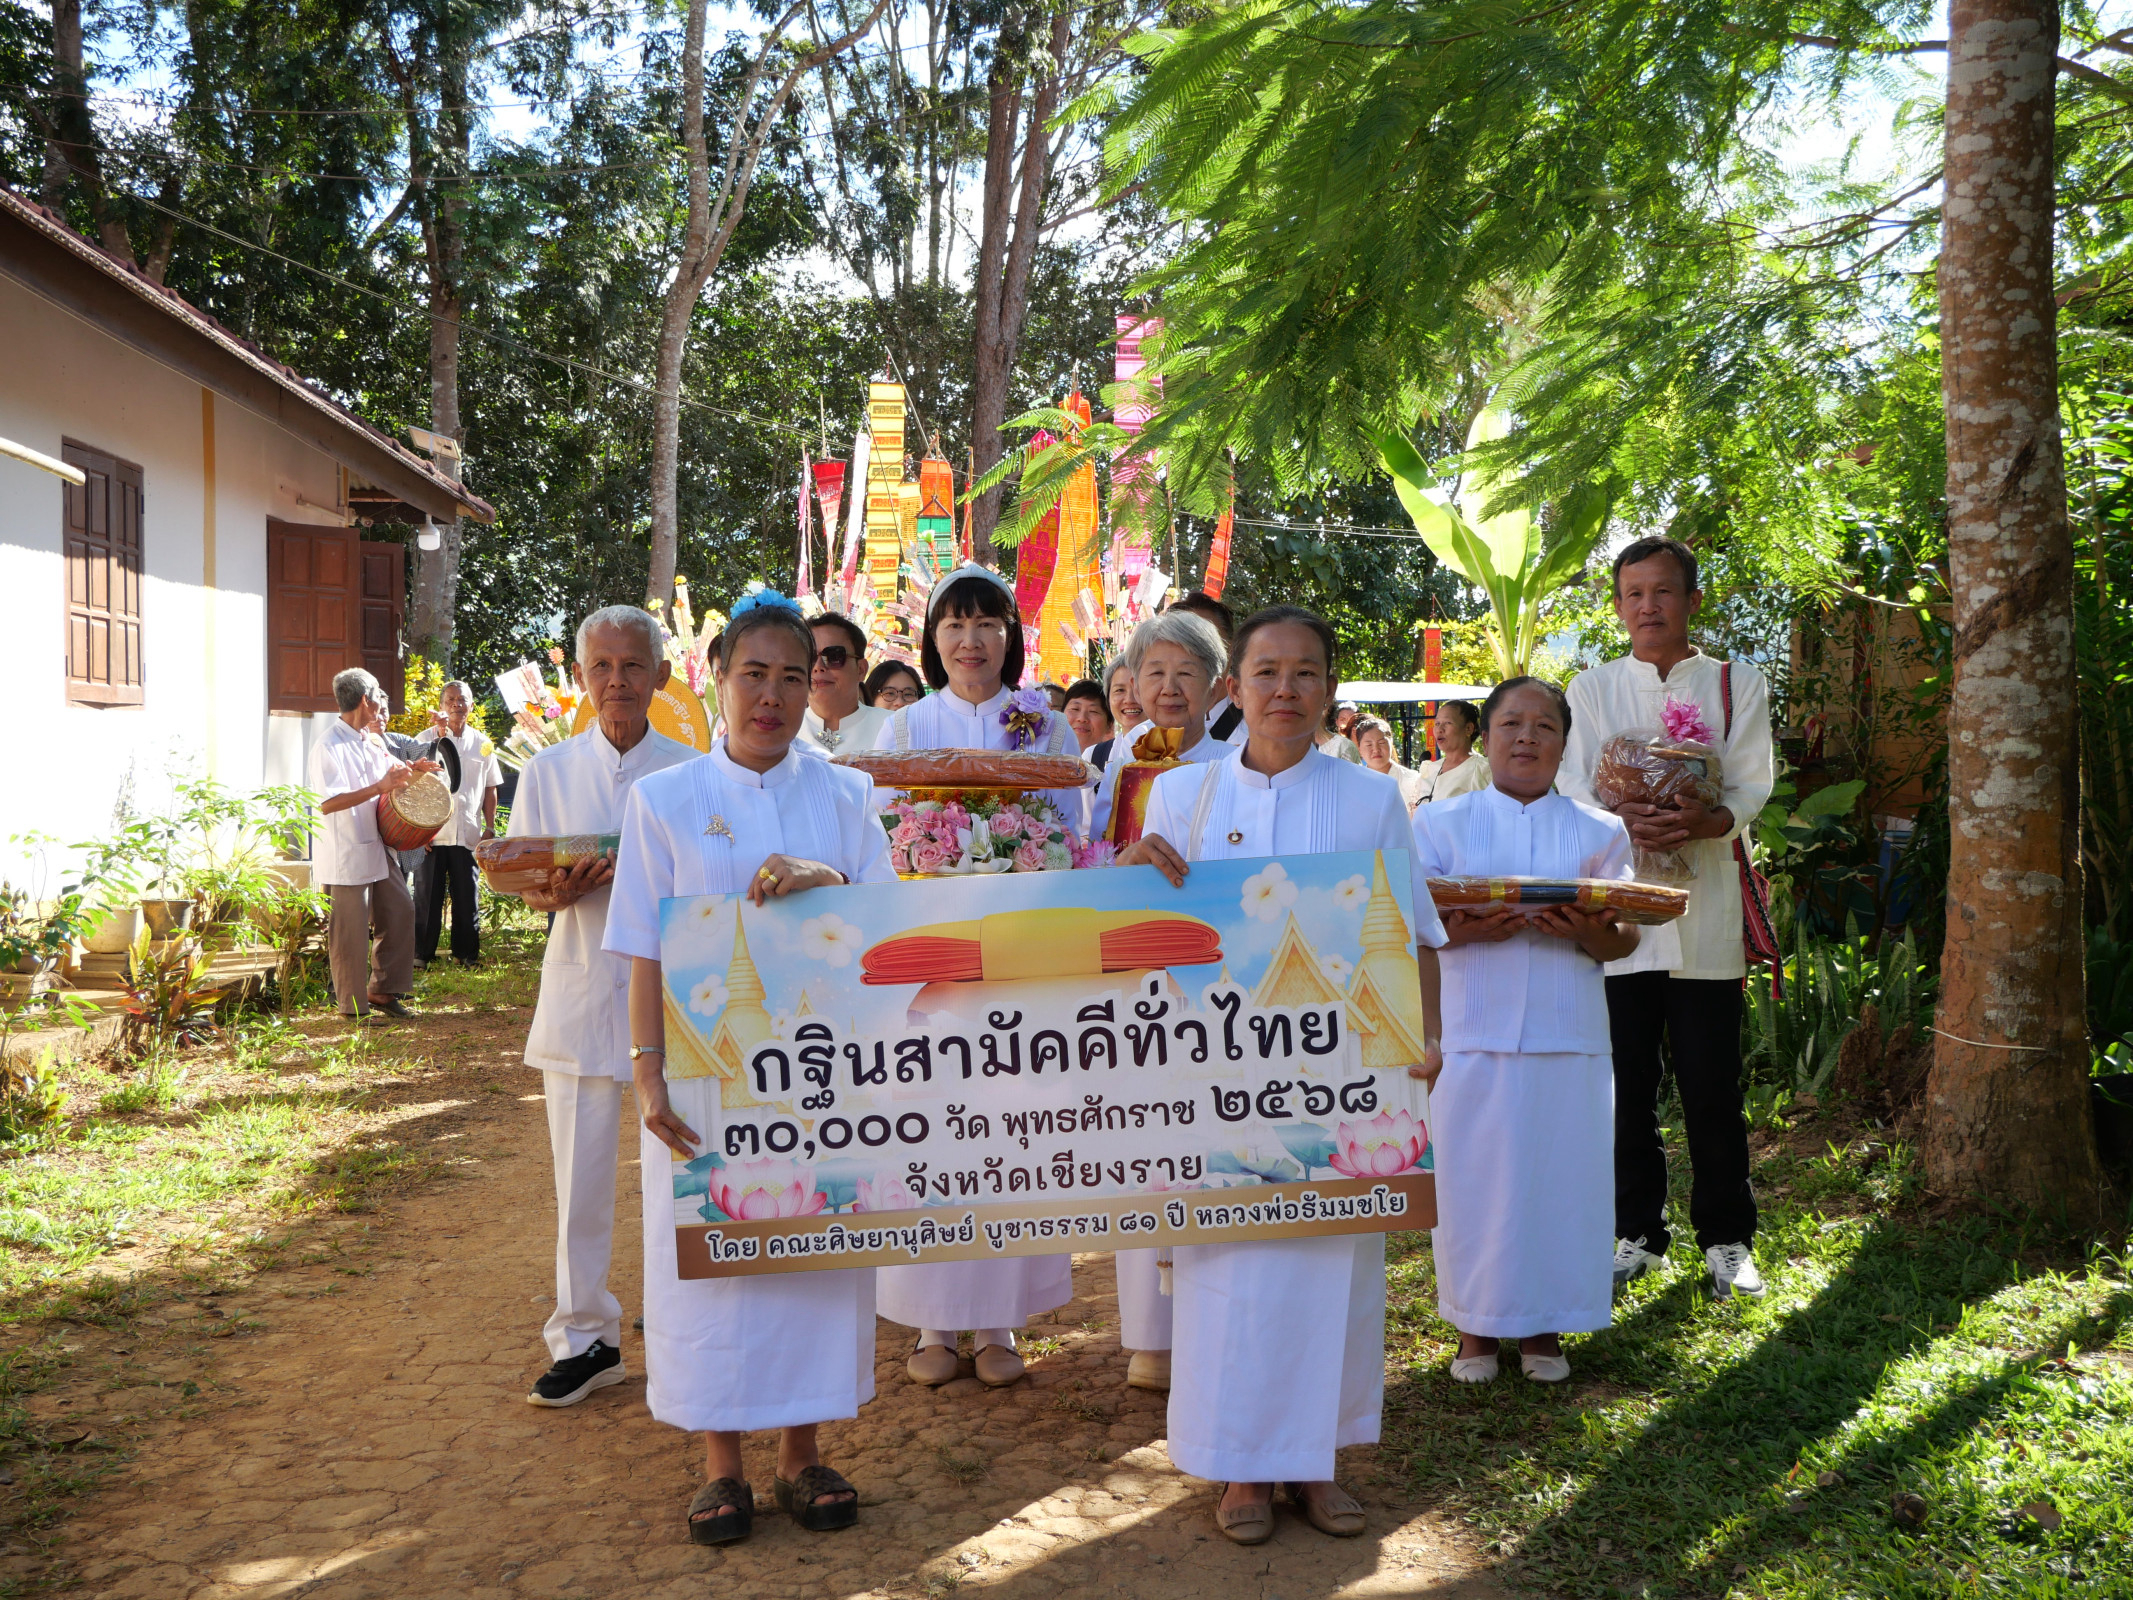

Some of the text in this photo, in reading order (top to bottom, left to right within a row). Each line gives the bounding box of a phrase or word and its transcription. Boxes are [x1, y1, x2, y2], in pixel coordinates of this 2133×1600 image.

[751, 980, 1340, 1110] กฐินสามัคคีทั่วไทย
[724, 1074, 1378, 1160] ๓๐,๐๐๐ วัด พุทธศักราช ๒๕๖๘
[905, 1149, 1203, 1199] จังหวัดเชียงราย
[708, 1187, 1406, 1260] โดย คณะศิษยานุศิษย์ บูชาธรรม ๘๑ ปี หลวงพ่อธัมมชโย
